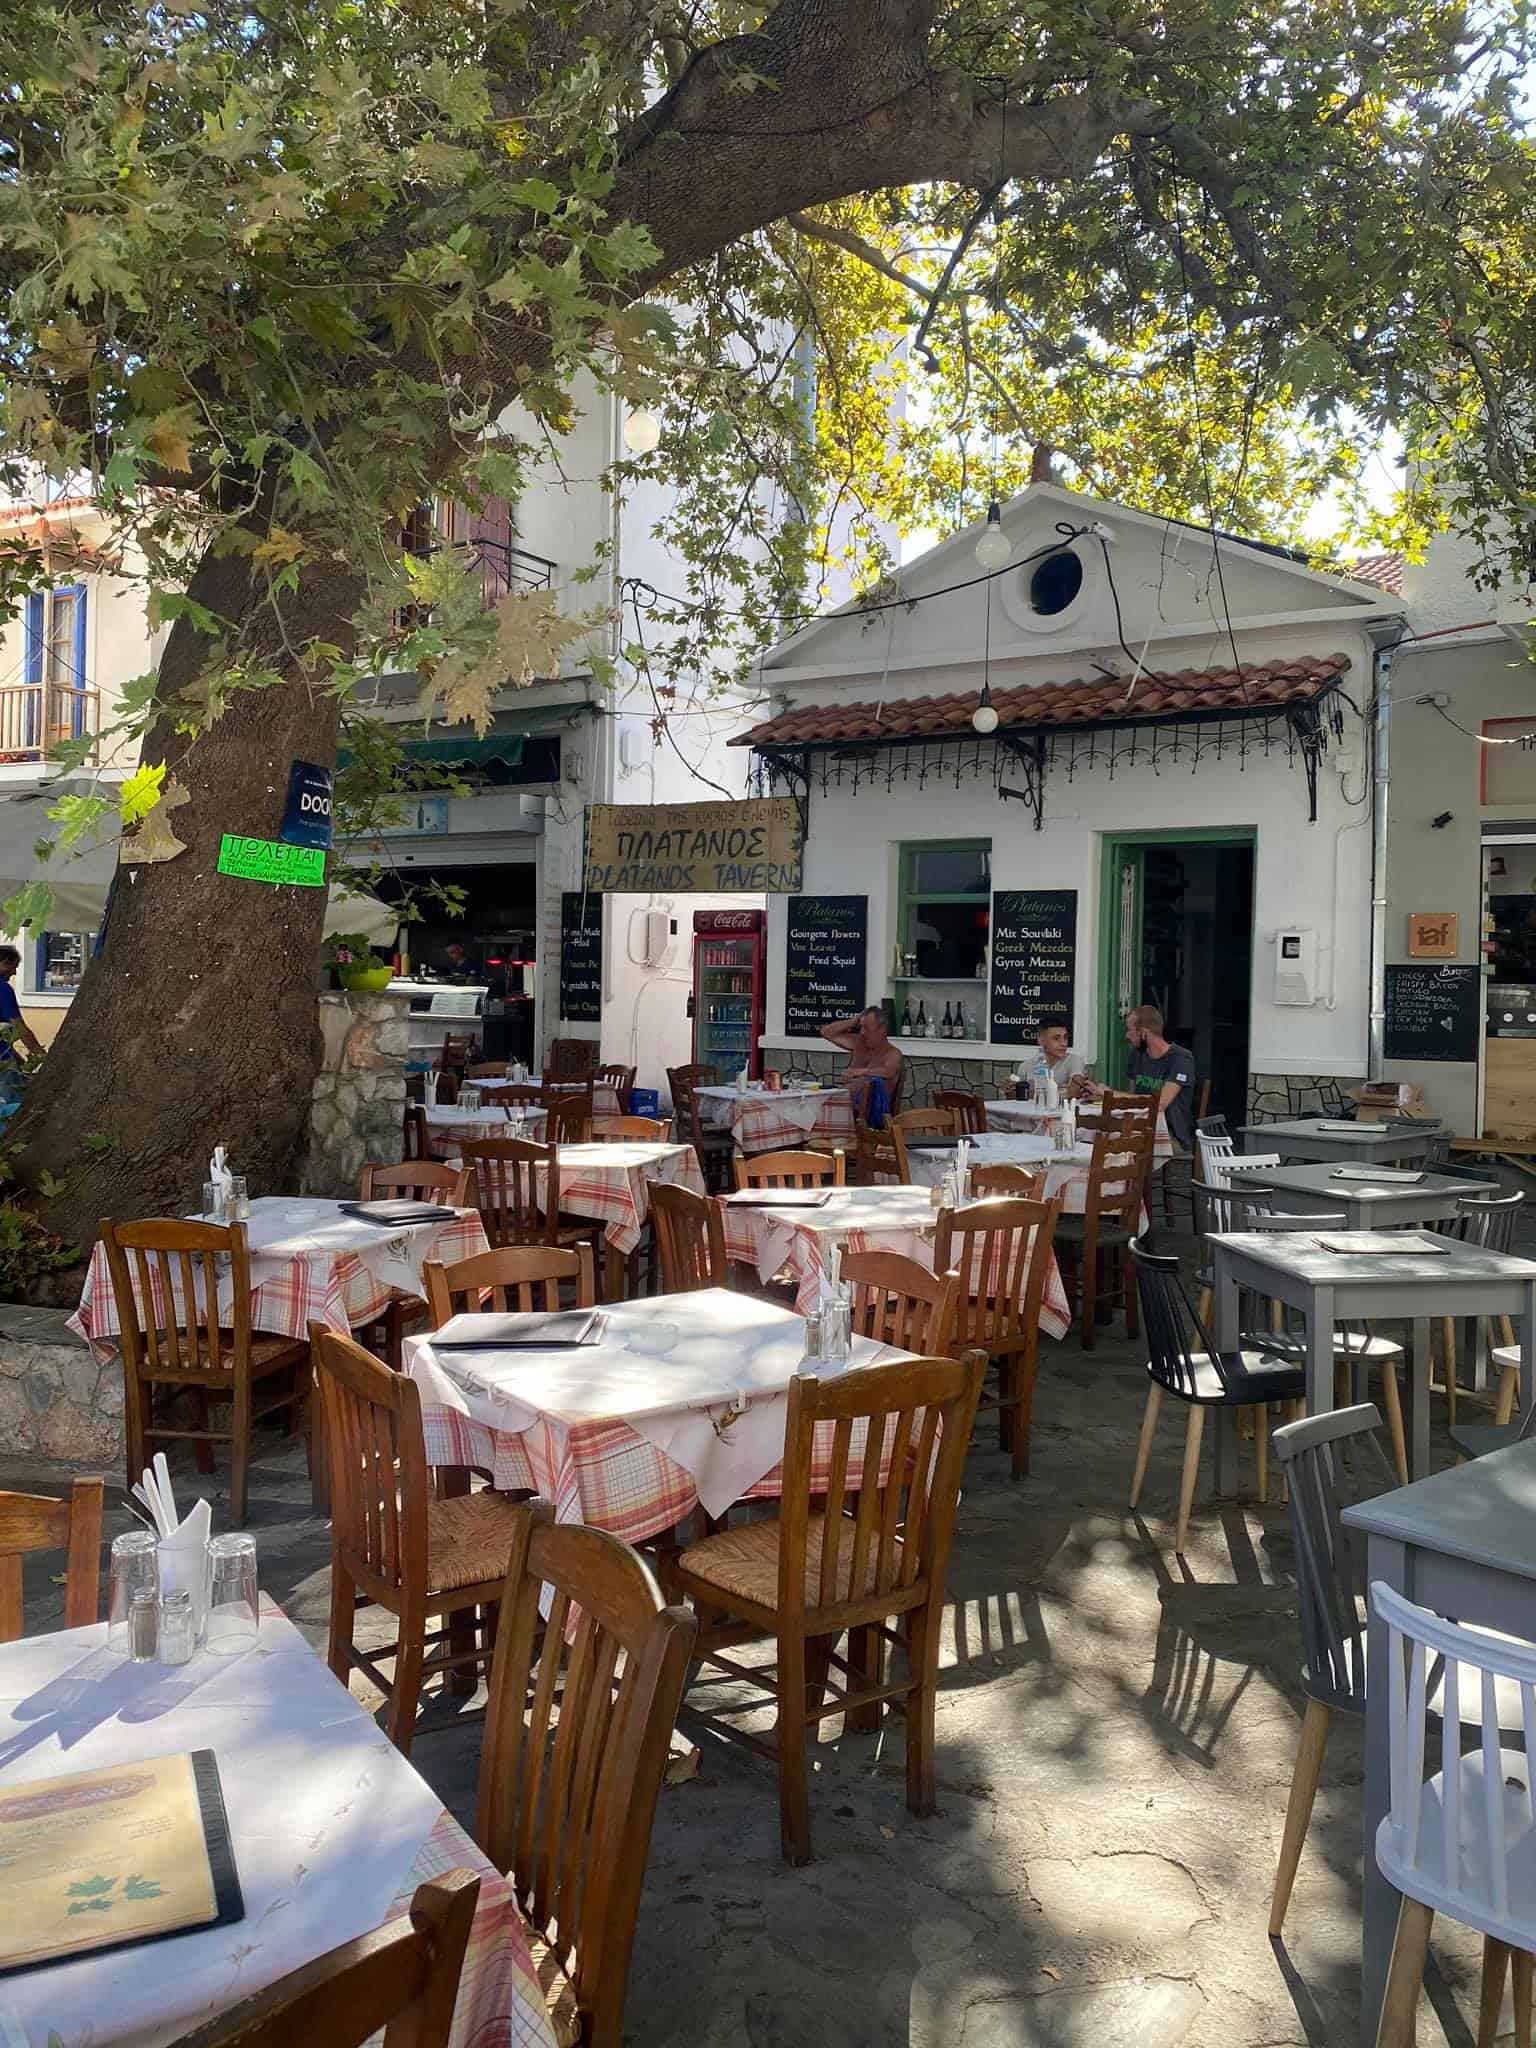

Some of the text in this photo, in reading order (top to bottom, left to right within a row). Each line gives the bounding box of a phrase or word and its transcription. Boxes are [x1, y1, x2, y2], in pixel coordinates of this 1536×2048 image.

[617, 827, 767, 860] ΠΛΑΤΑΝΟΣ
[589, 863, 696, 890] PLATANOS
[996, 927, 1062, 938] Mix Souvlaki
[996, 942, 1073, 953] Greek Mezedes
[808, 956, 856, 968] Fried Squid
[995, 956, 1066, 969] Gyros Metaxa
[1020, 971, 1070, 982] Tenderloin
[995, 985, 1040, 996] Mix Grill
[789, 1008, 818, 1018] Chicken
